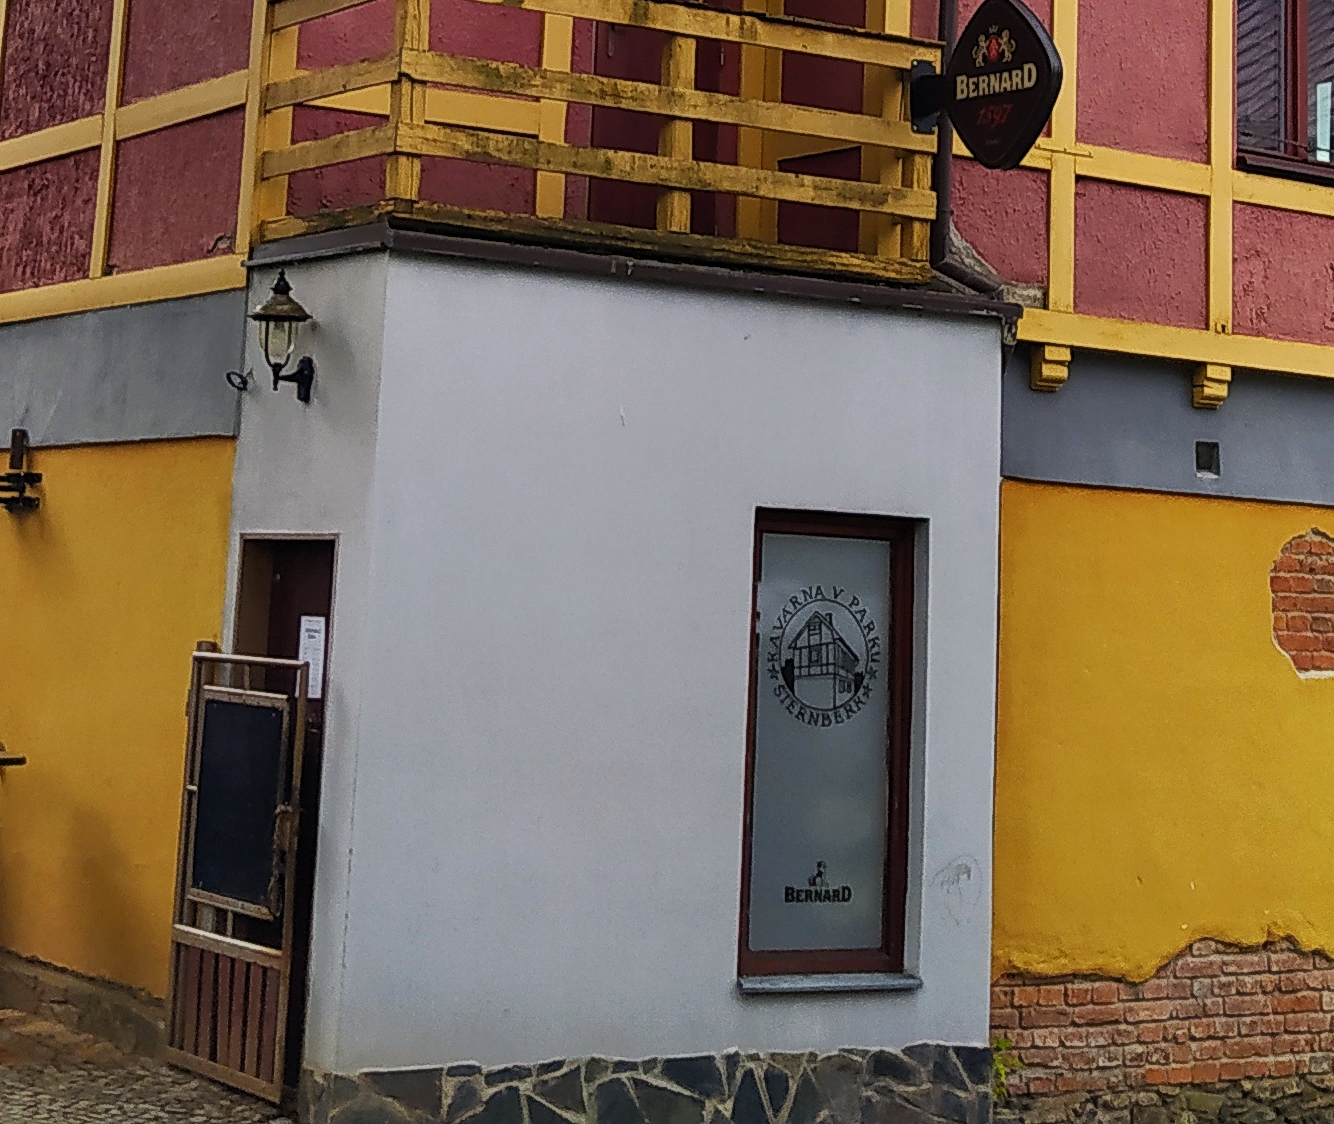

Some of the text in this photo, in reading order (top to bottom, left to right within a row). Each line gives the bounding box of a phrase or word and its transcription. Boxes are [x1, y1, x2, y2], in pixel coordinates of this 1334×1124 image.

[955, 62, 1038, 101] BERNARD
[833, 585, 845, 599] V
[848, 595, 880, 663] PARKU
[784, 885, 852, 903] BERNARD
